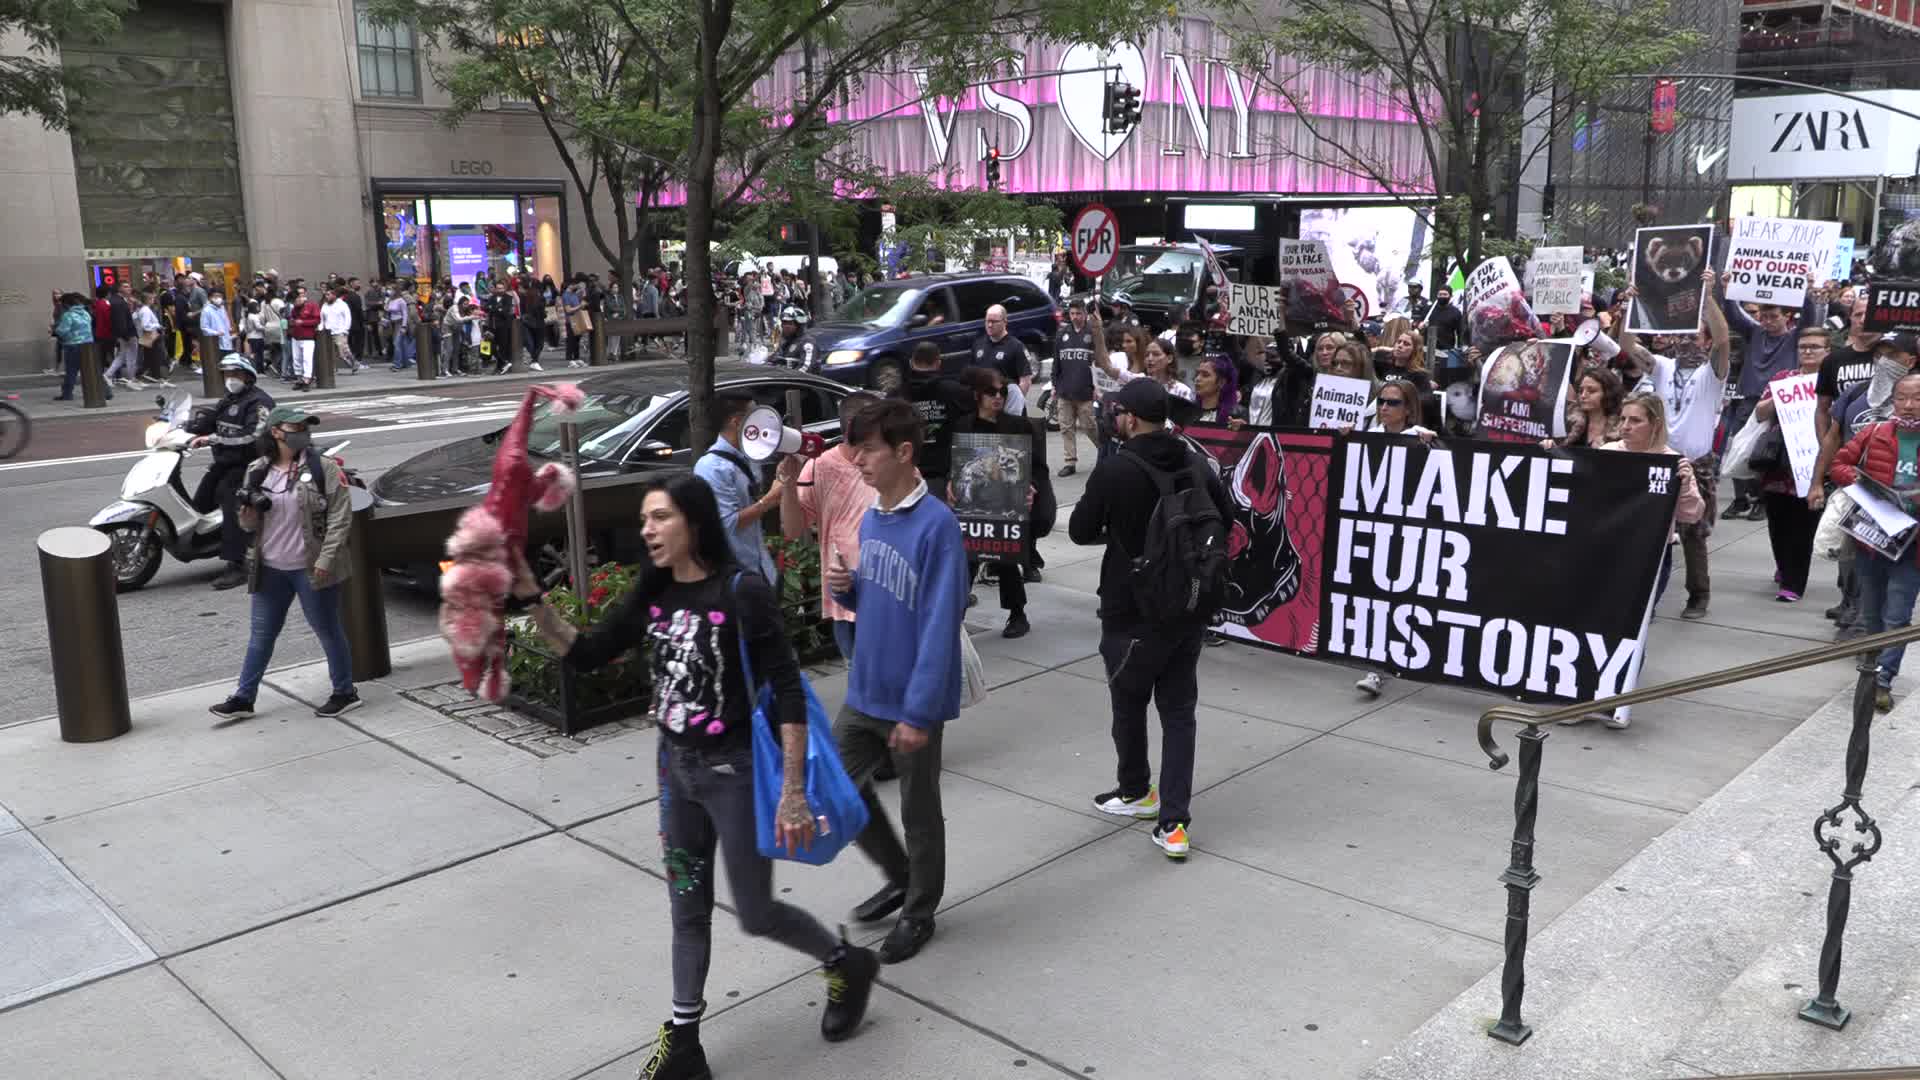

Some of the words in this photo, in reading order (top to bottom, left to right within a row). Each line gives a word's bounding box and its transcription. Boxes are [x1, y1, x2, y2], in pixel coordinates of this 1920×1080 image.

[909, 51, 1033, 166] VS
[1161, 52, 1271, 159] NY
[1770, 109, 1870, 152] ZARA
[450, 160, 492, 175] LEGO
[1739, 220, 1782, 240] WEAR
[1078, 228, 1111, 254] FUR
[1303, 253, 1323, 265] FACE
[1735, 248, 1784, 260] ANIMALS
[1787, 252, 1810, 262] ARE
[1535, 262, 1578, 275] ANIMALS
[1732, 258, 1762, 271] NOT
[1766, 261, 1808, 275] OURS
[1732, 271, 1751, 285] TO
[1756, 274, 1805, 290] WEAR
[1232, 284, 1269, 308] FUR
[1479, 281, 1508, 302] VEGAN
[1877, 290, 1920, 307] FUR
[1228, 316, 1280, 336] CRUEL
[1315, 386, 1365, 407] Animals
[1776, 382, 1816, 404] BAN
[1314, 404, 1334, 420] Are
[1337, 408, 1360, 424] Not
[1503, 400, 1508, 413] I
[1511, 402, 1530, 417] AM
[1340, 442, 1574, 535] MAKE
[959, 522, 995, 538] FUR
[1003, 524, 1021, 540] IS
[1333, 518, 1471, 601] FUR
[1328, 592, 1639, 701] HISTORY
